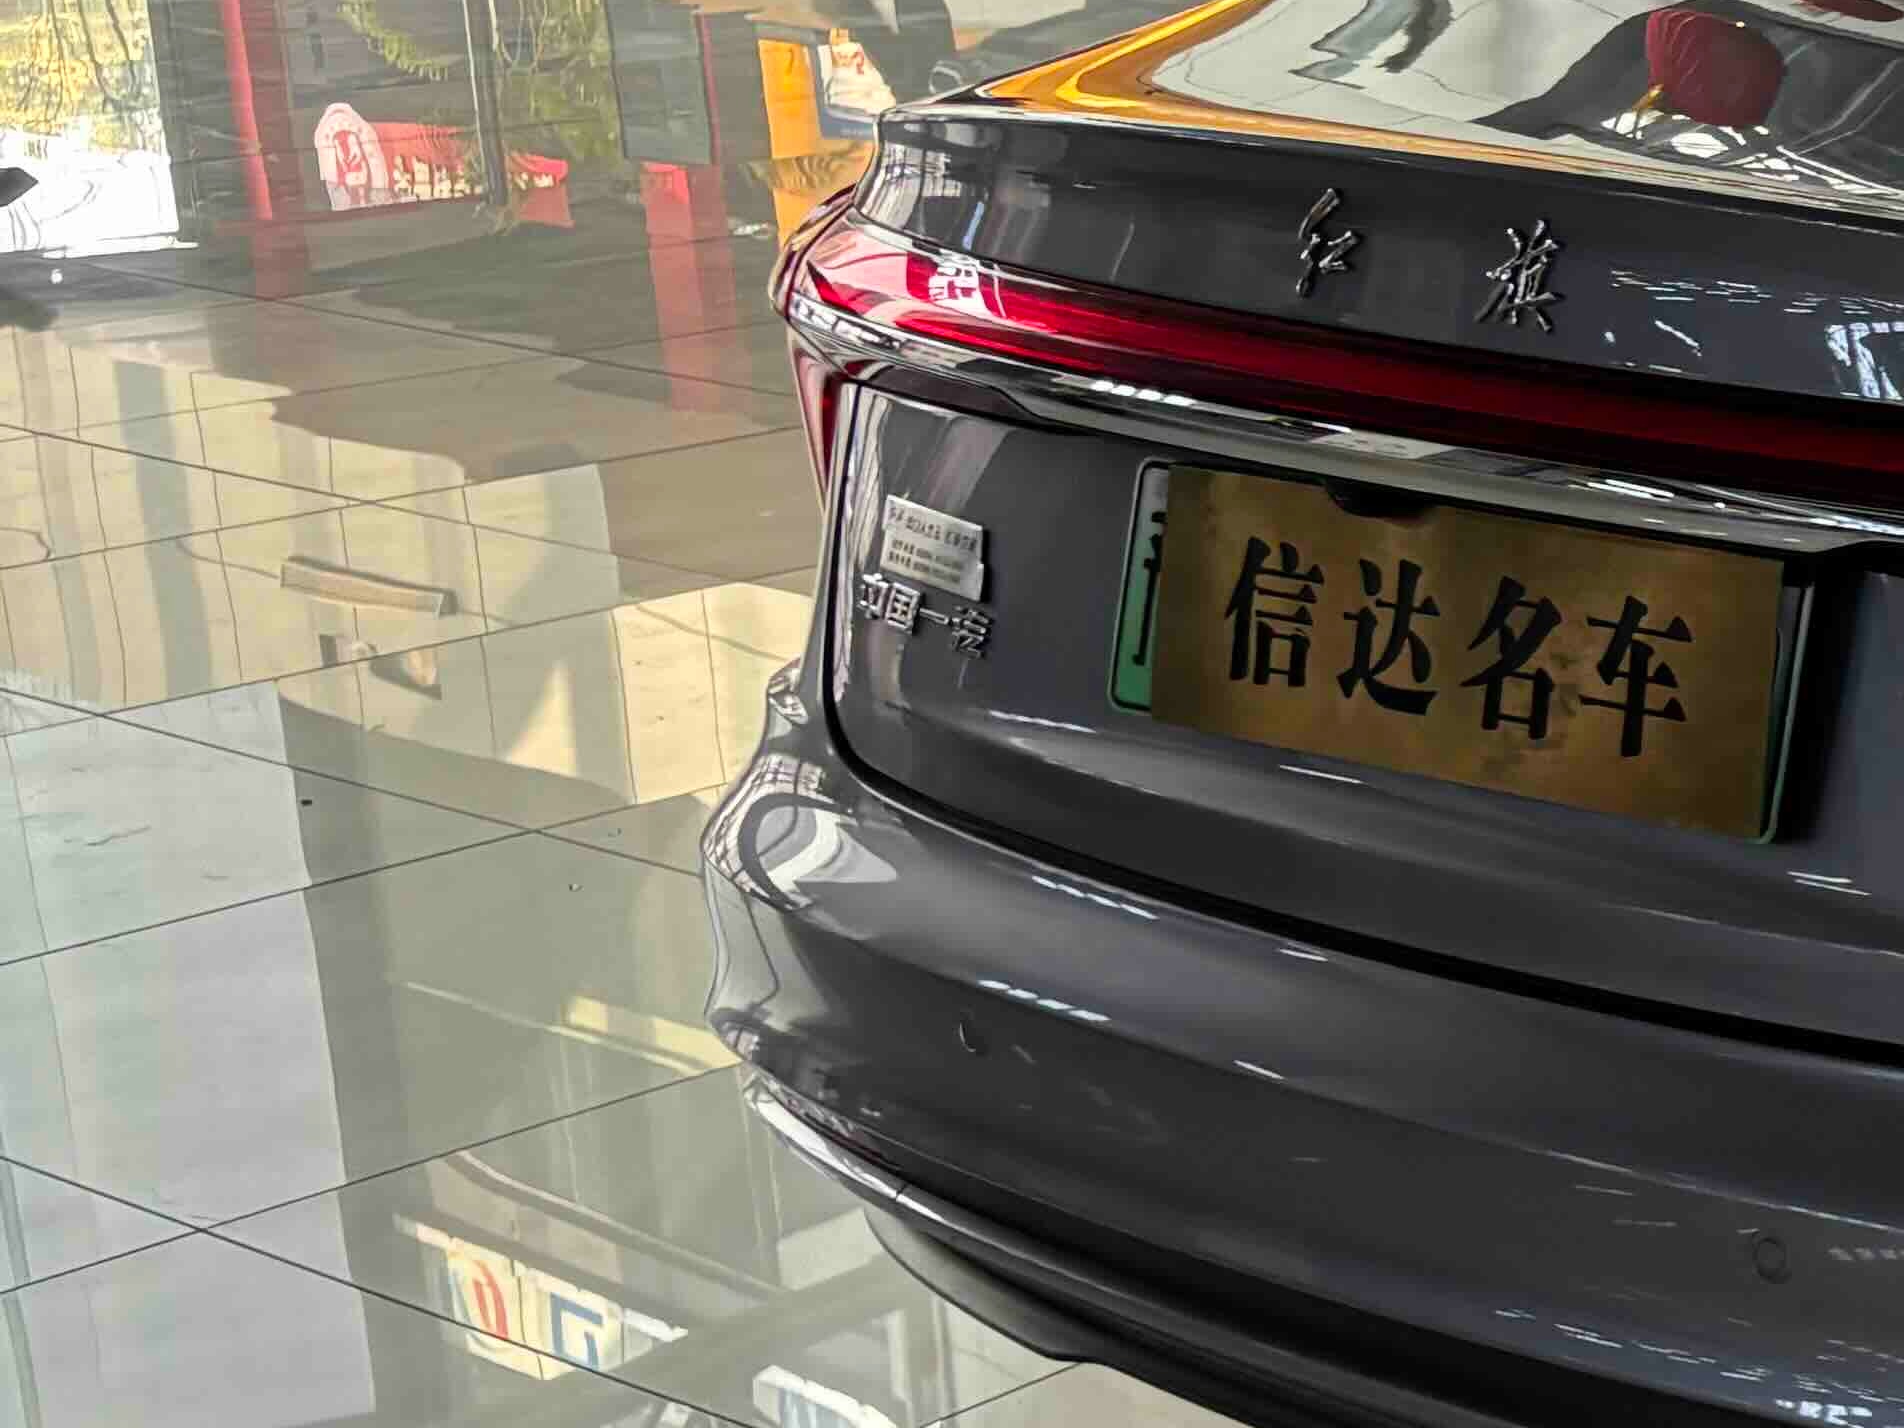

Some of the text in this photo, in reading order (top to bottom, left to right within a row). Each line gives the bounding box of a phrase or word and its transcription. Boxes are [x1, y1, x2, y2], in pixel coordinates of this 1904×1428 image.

[1295, 187, 1564, 334] 红旗
[857, 572, 990, 660] 中国一汽
[1223, 536, 1693, 758] 信达名车
